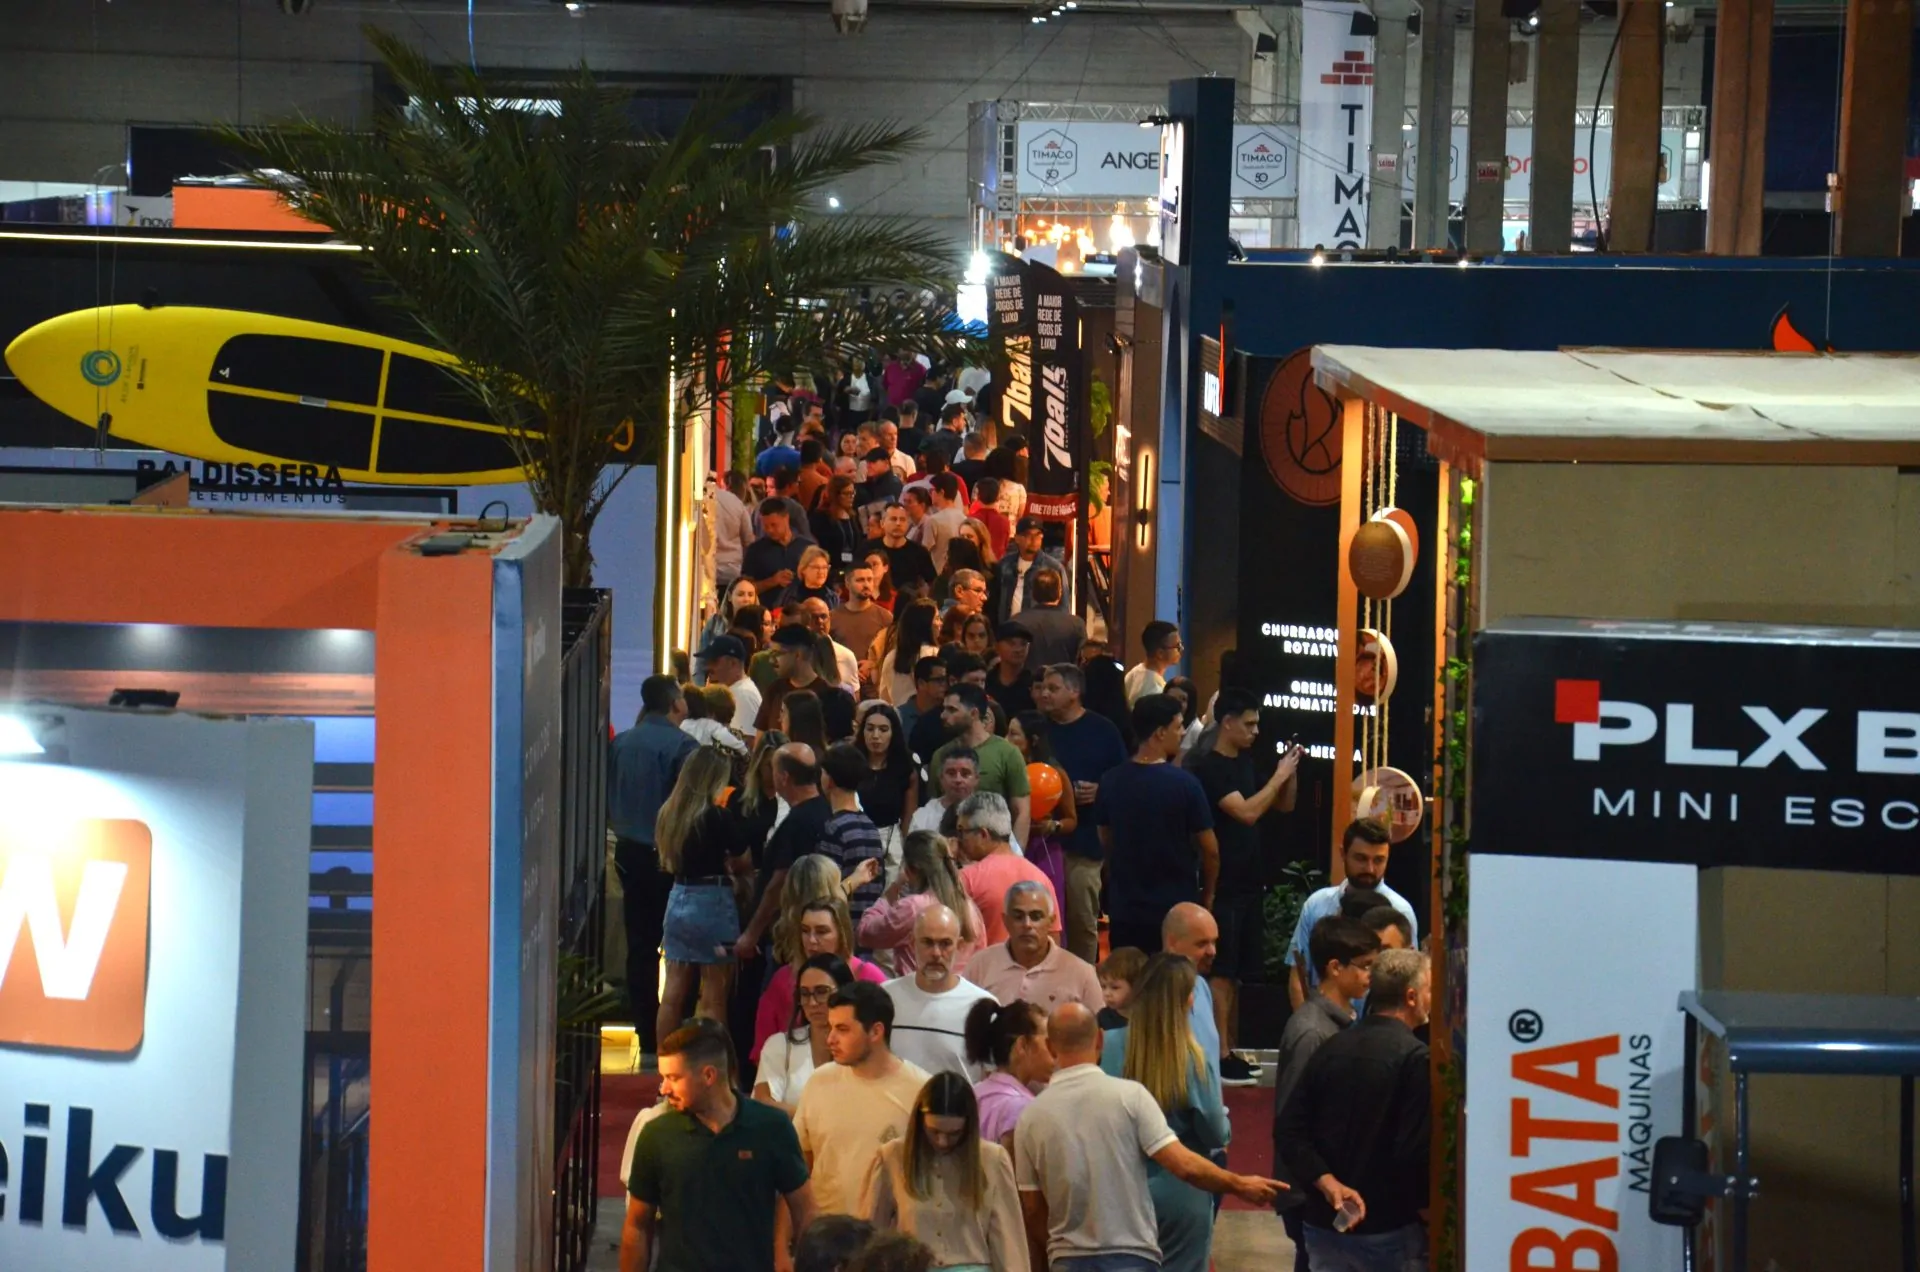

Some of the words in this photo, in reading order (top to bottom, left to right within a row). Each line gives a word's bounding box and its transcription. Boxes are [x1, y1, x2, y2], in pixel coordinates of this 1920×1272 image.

[1032, 150, 1073, 160] TIMACO
[1101, 151, 1159, 169] ANGE
[1241, 153, 1283, 163] TIMACO
[1255, 172, 1269, 183] 50
[1573, 700, 1829, 771] PLX
[1593, 787, 1738, 822] MINI
[1622, 1033, 1653, 1193] MÁQUINAS
[0, 1103, 229, 1240] iku
